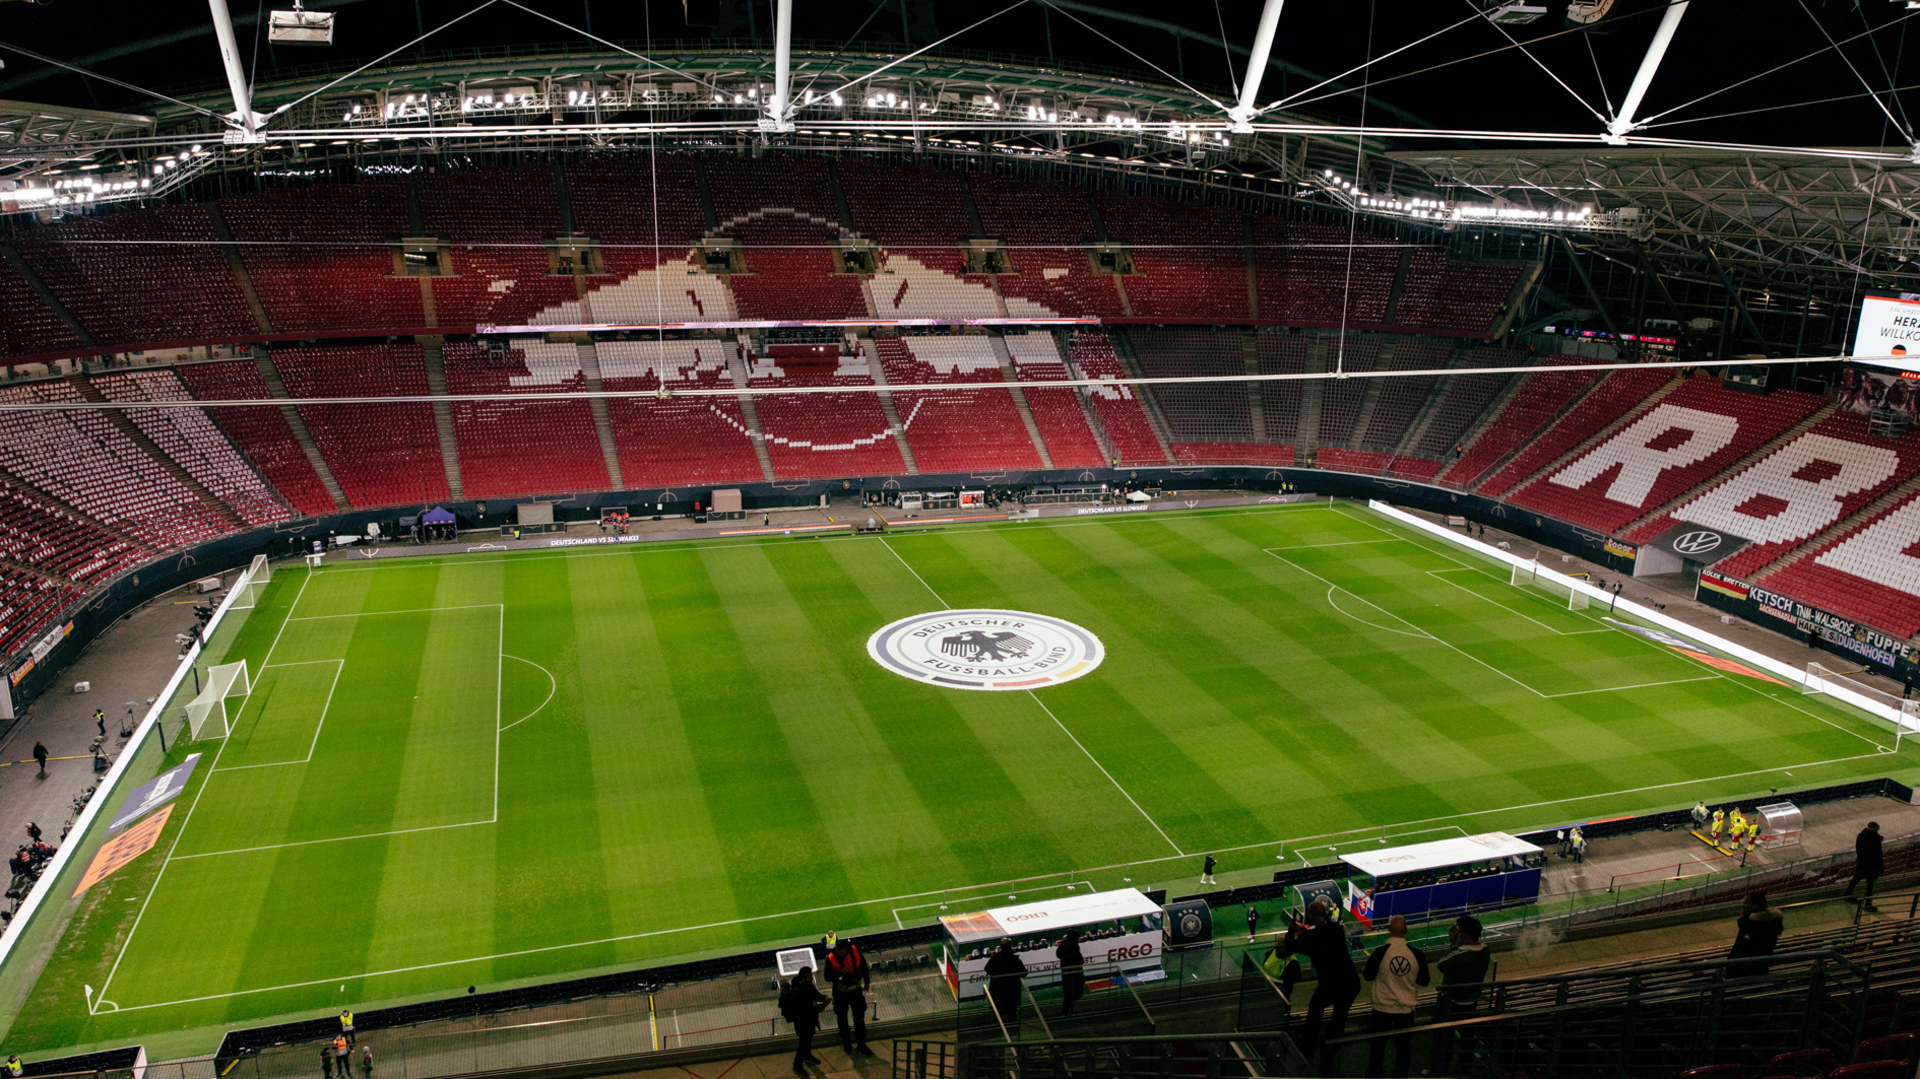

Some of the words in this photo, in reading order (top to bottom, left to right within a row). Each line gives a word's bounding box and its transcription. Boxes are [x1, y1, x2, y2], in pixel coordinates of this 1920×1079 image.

[551, 538, 597, 546] DEUTSCHLAND
[1749, 586, 1794, 612] KETSCH
[1759, 603, 1797, 624] SACHSENADLER
[913, 619, 1025, 637] DEUTSCHER
[1837, 633, 1896, 668] DUDENHOFEN
[1866, 630, 1911, 658] FUPPE
[924, 646, 1066, 675] FUSSBALL-BUND
[1006, 911, 1048, 922] ERGO
[1107, 943, 1153, 962] ERGO
